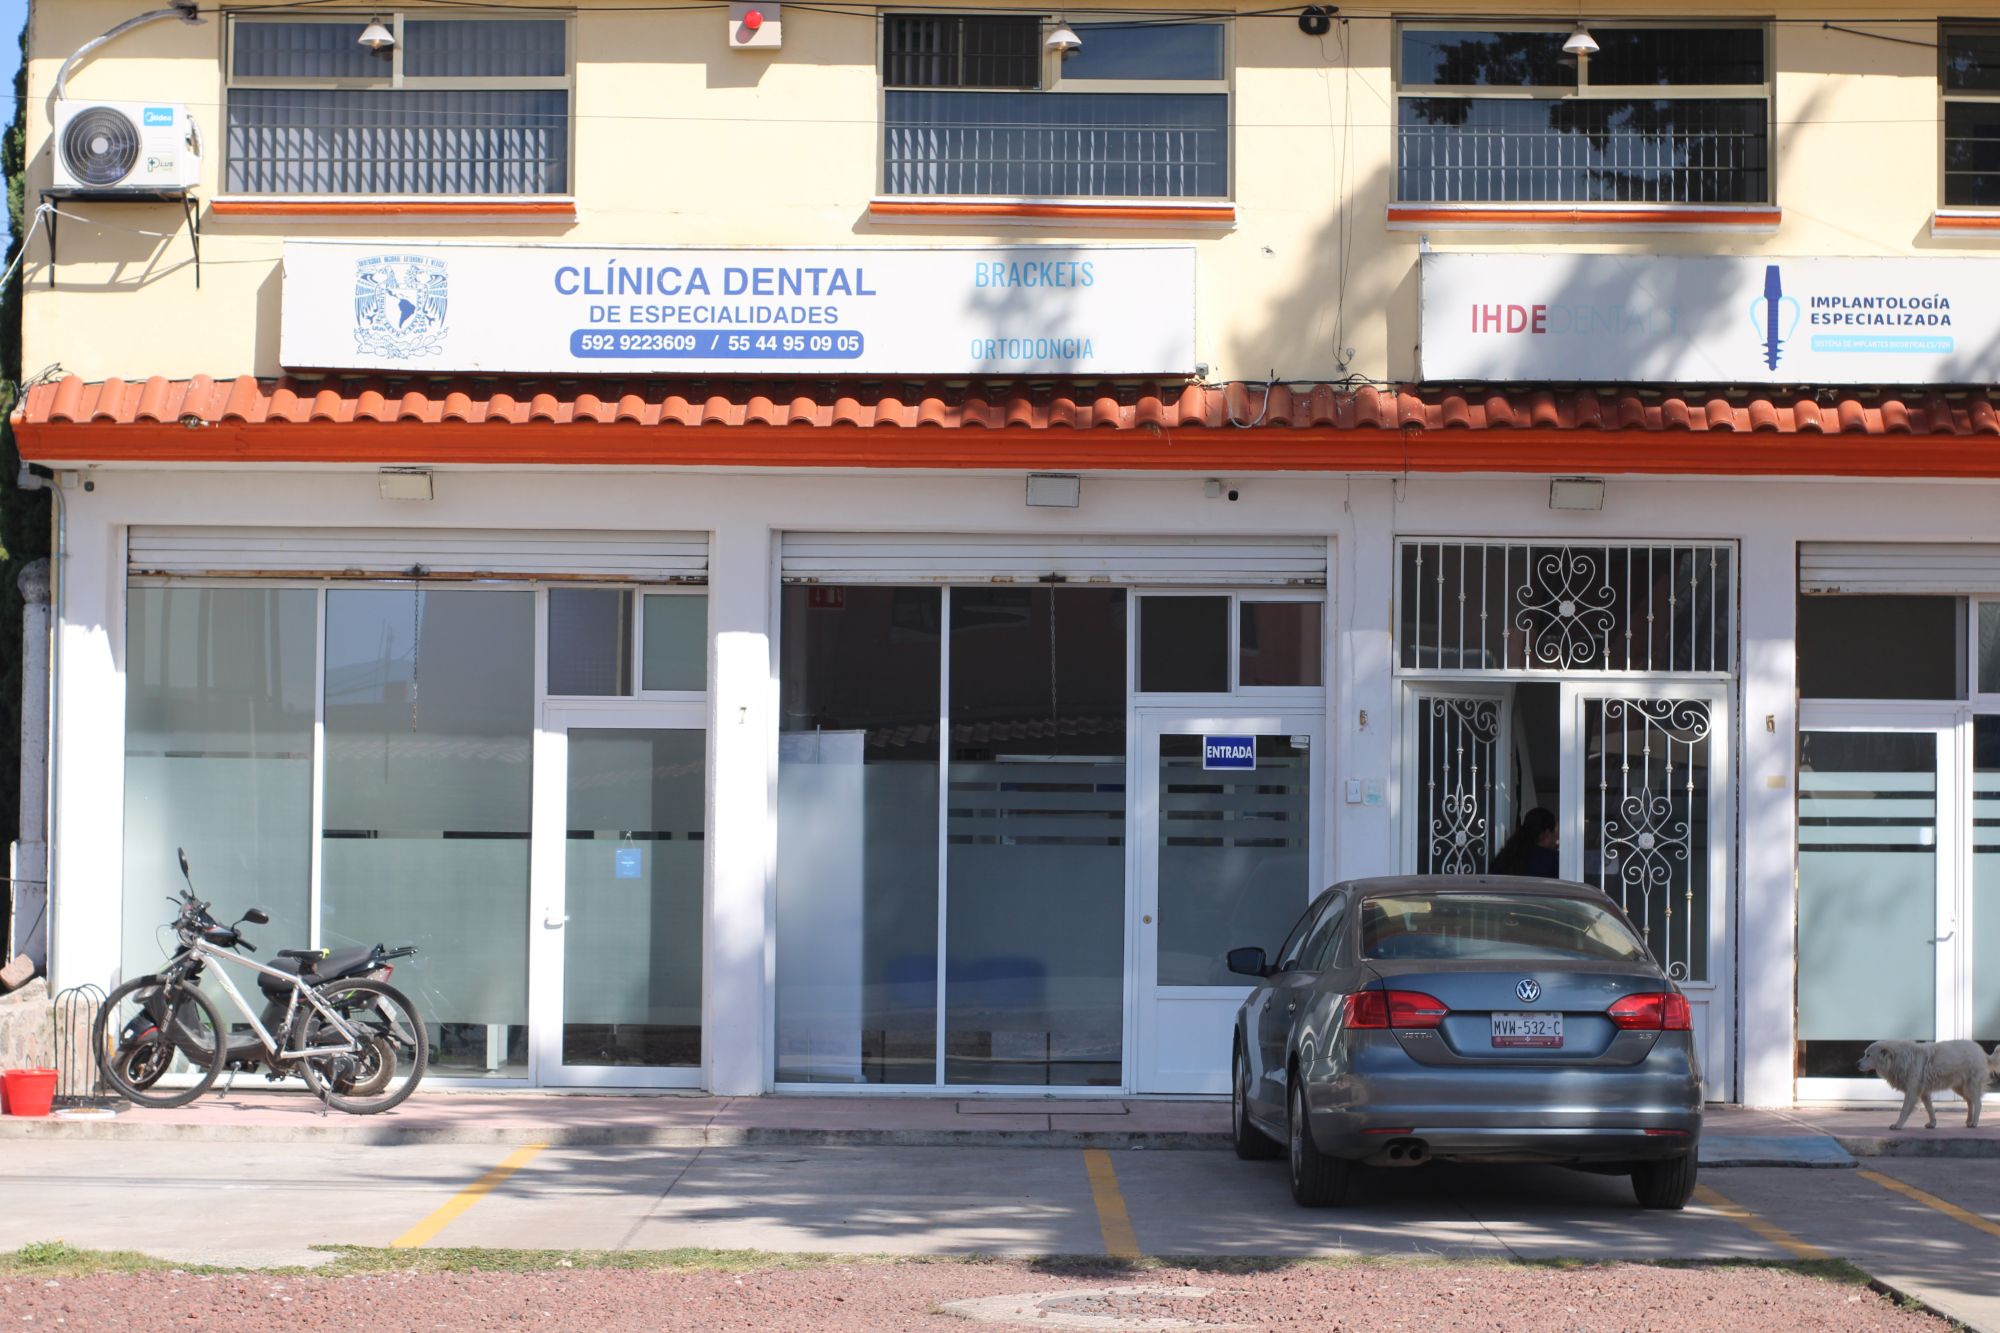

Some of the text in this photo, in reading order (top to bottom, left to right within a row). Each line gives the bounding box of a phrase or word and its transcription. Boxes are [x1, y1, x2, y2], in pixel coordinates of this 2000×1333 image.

[554, 259, 876, 295] CLÍNICA DENTAL
[975, 261, 1094, 288] BRACKETS
[1810, 293, 1950, 309] IMPLANTOLOGÍA
[589, 305, 838, 324] DE ESPECIALIDADES
[1810, 312, 1952, 326] ESPECIALIZADA
[581, 334, 615, 350] 592
[619, 334, 696, 351] 9223609
[728, 335, 751, 351] 55
[755, 335, 777, 351] 44
[783, 335, 805, 352] 95
[810, 335, 833, 352] 09
[837, 335, 860, 352] 05
[971, 338, 1094, 360] ORTODONCIA
[1206, 745, 1253, 759] ENTRADA
[1494, 1020, 1561, 1035] MVW-532-C
